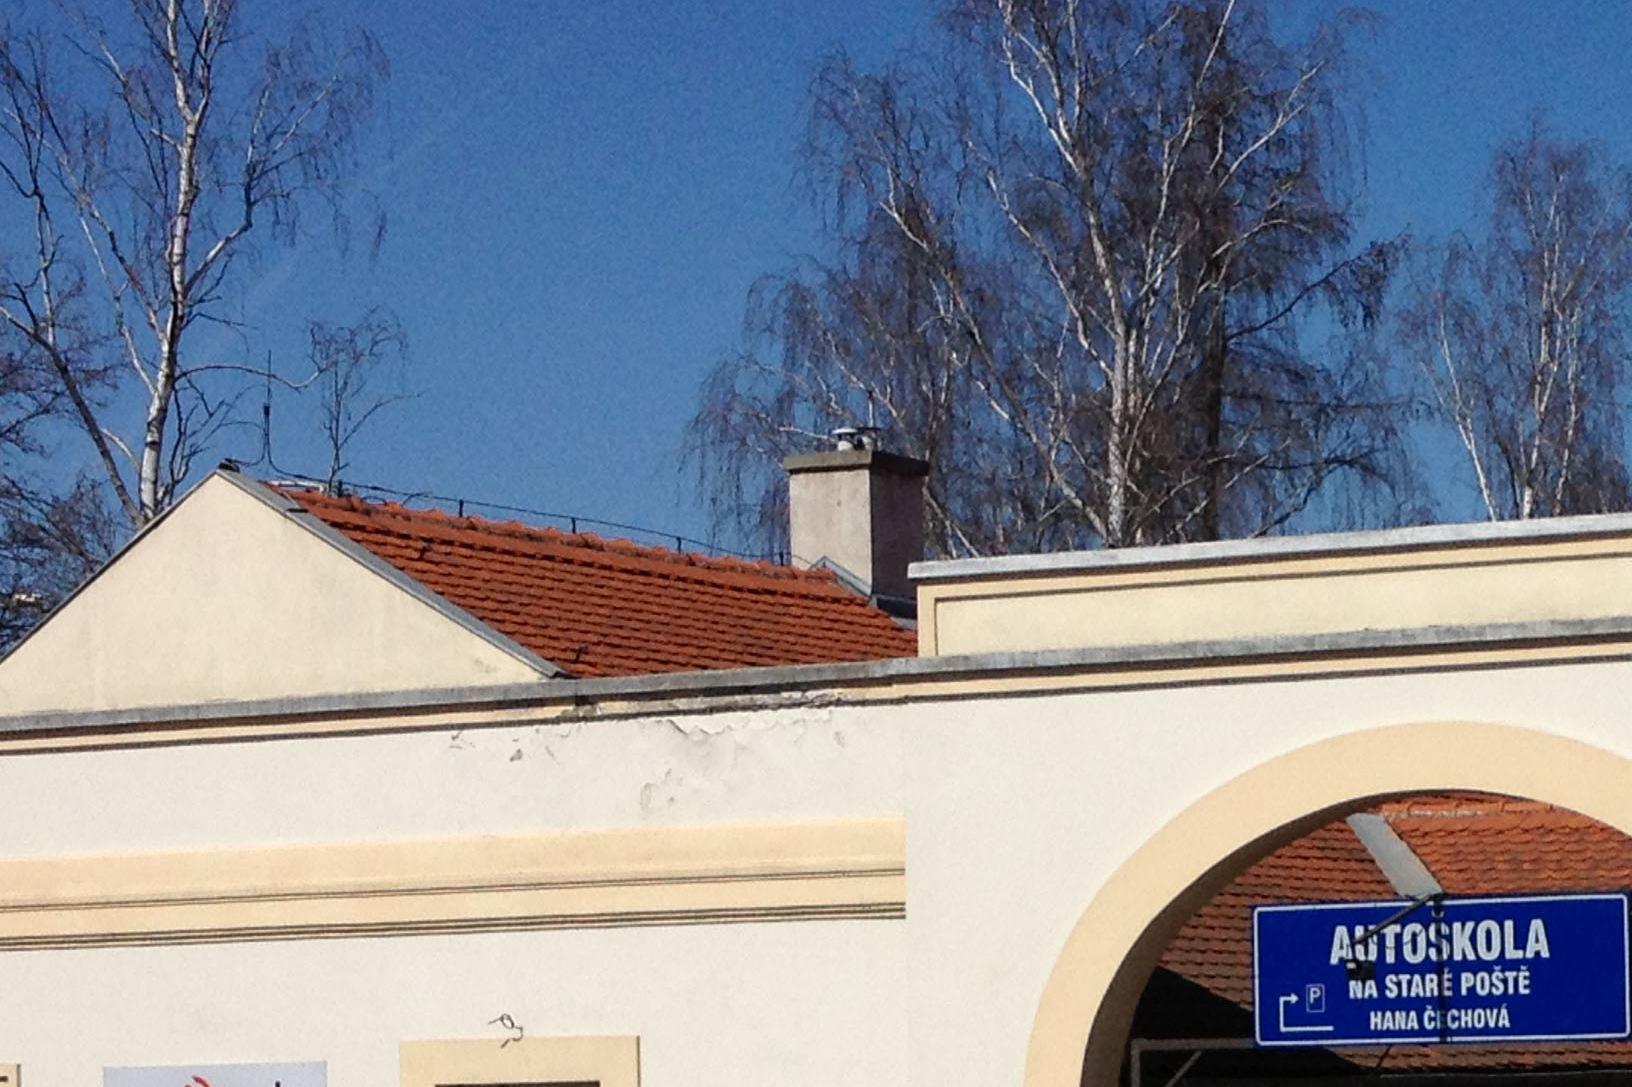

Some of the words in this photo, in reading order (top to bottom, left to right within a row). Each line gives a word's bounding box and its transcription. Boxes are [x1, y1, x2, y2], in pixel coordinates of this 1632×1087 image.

[1349, 978, 1378, 1000] NA
[1385, 967, 1453, 999] STARÉ
[1460, 965, 1531, 997] POŠTĚ
[1370, 1010, 1420, 1031] HANA
